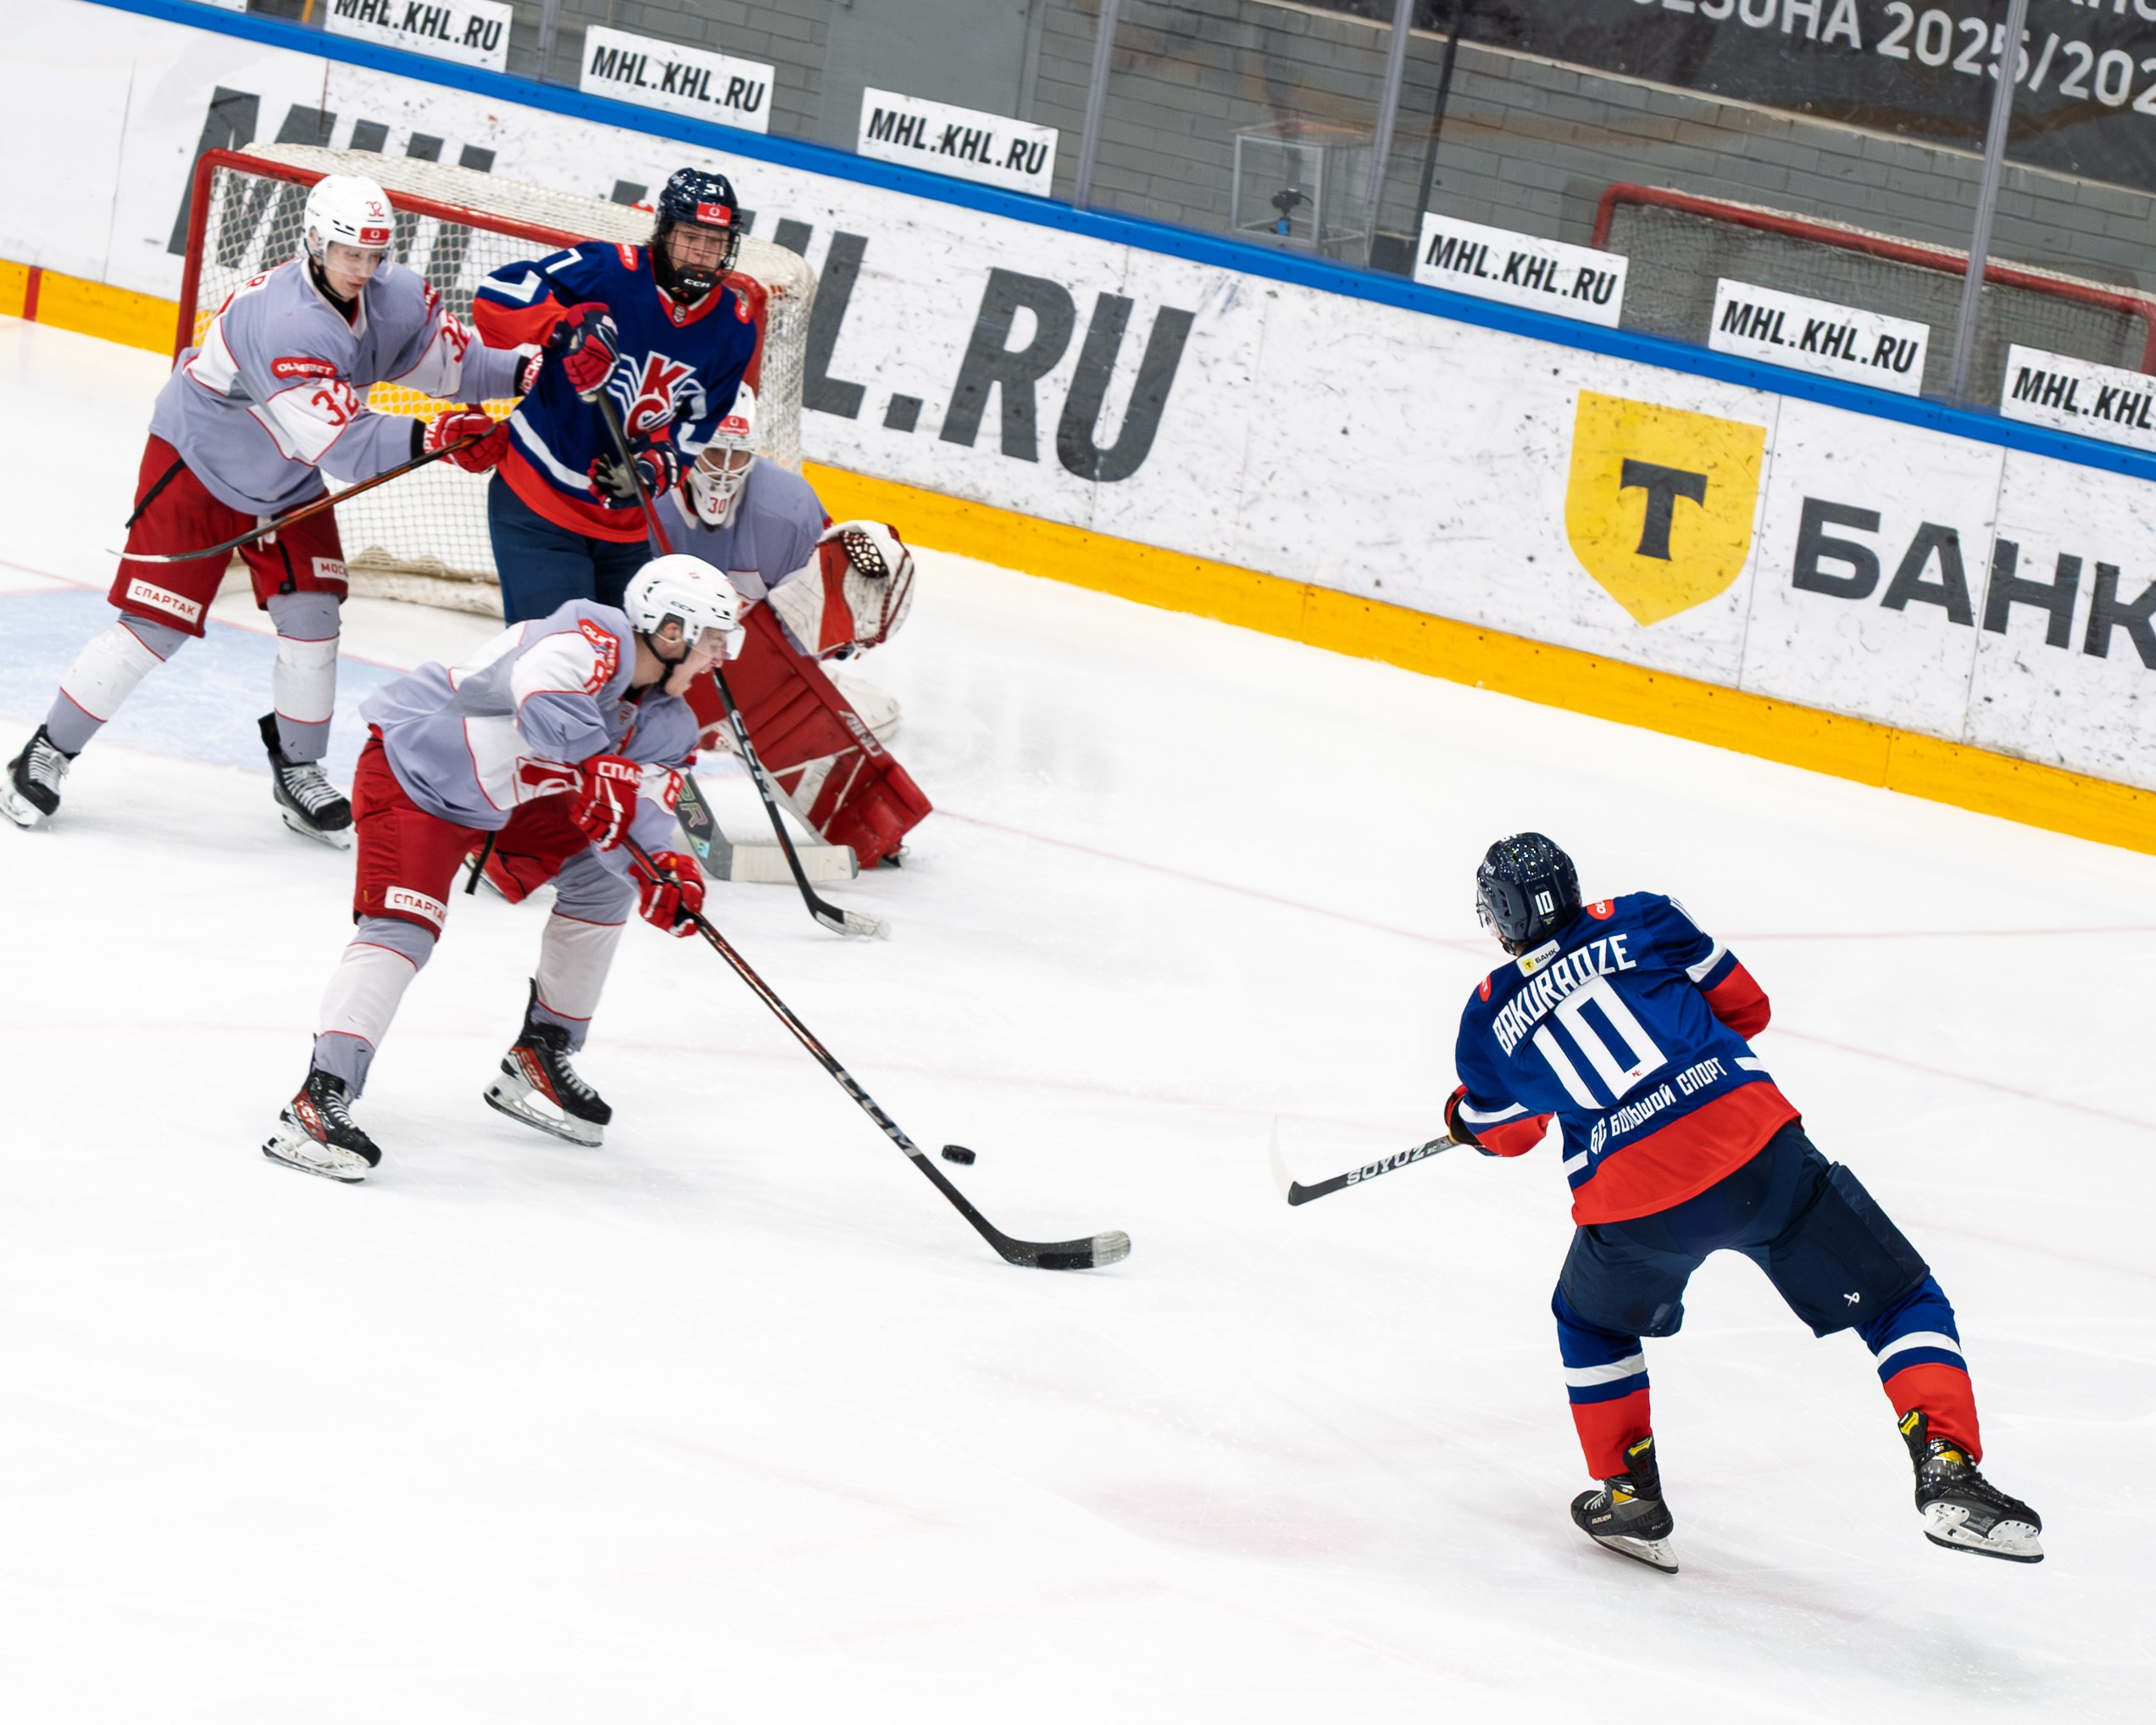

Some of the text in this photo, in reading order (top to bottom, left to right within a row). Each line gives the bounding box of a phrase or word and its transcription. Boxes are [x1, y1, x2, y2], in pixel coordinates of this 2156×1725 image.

[590, 46, 764, 113] MHL.KHL.RU
[867, 108, 1048, 175] MHL.KHL.RU
[1425, 234, 1618, 305] MHL.KHL.RU
[1720, 300, 1919, 373] MHL.KHL.RU
[310, 380, 360, 426] 32
[707, 496, 728, 515] 30
[134, 585, 196, 616] СПАРТАК
[1535, 890, 1555, 916] 10
[1535, 949, 1558, 964] БАНК
[1492, 933, 1637, 1057] BAKURADZE
[1532, 977, 1668, 1110] 10
[1675, 1057, 1728, 1096] СПОРТ
[1346, 1144, 1427, 1186] SOYUZ
